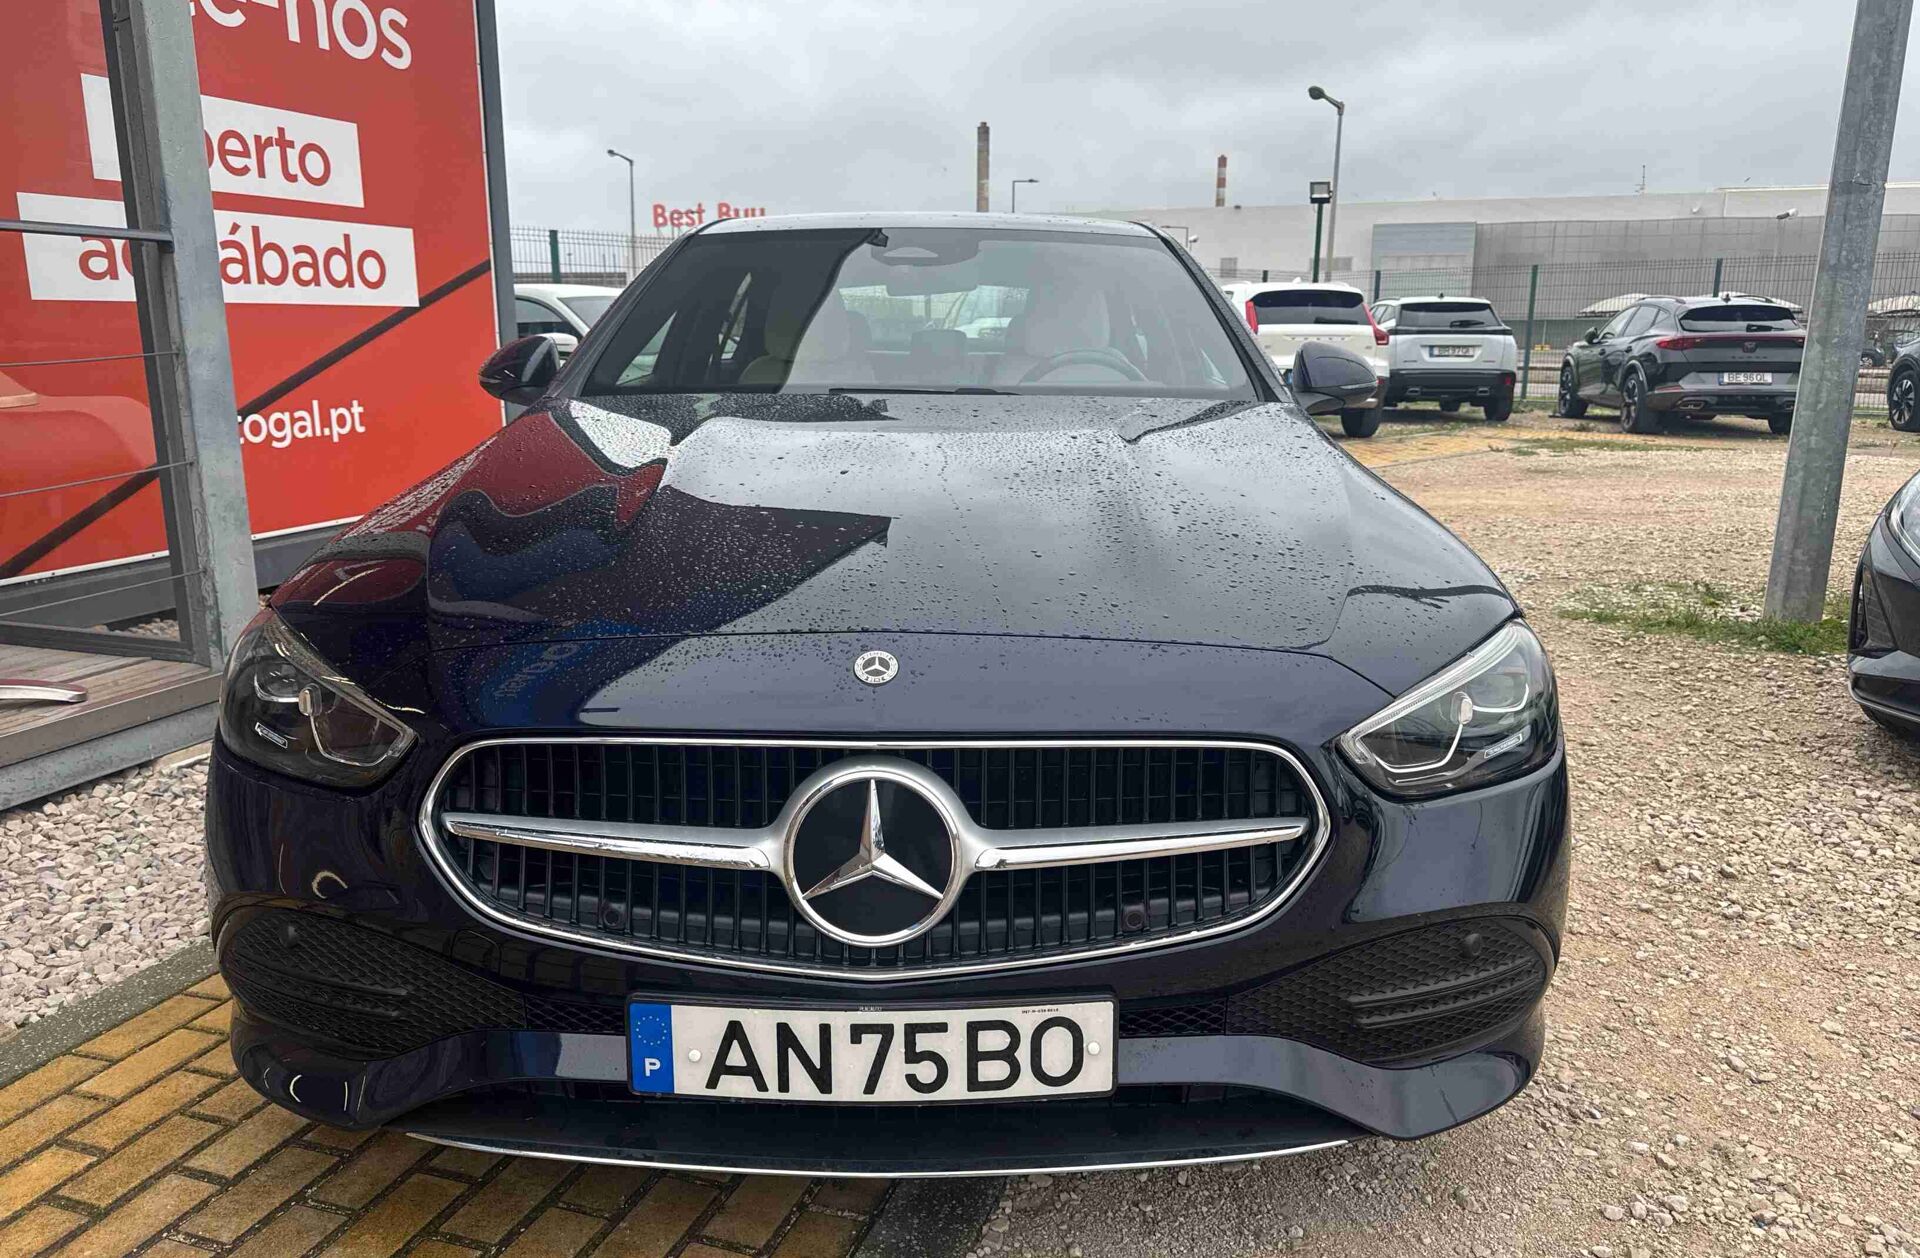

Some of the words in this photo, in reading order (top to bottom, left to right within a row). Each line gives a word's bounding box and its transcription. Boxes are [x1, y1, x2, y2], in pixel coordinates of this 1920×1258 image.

[204, 126, 331, 186] erto
[653, 203, 705, 228] Best
[219, 222, 386, 290] ábado
[237, 400, 366, 448] ogal.pt
[644, 1058, 661, 1077] P
